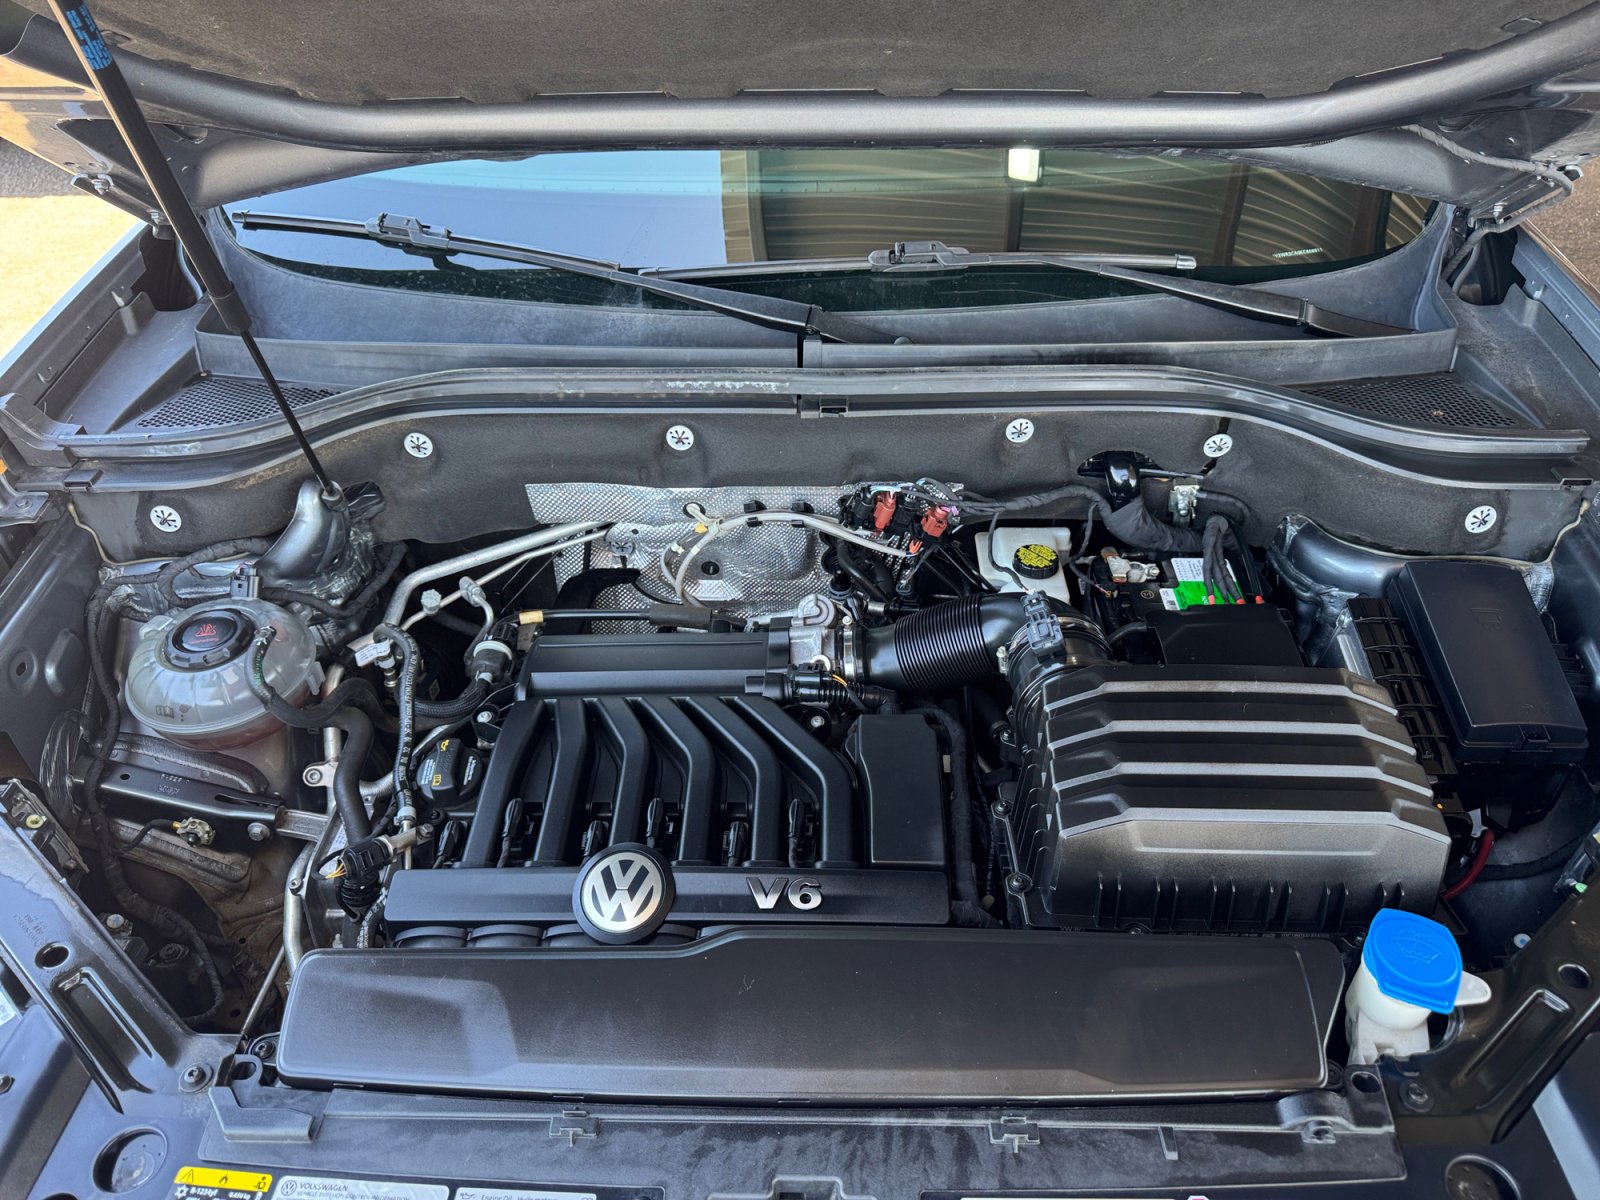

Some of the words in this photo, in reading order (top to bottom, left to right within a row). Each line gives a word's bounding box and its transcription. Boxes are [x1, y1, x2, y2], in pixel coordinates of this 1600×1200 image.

[582, 852, 664, 933] VW
[746, 876, 823, 911] V6
[300, 1182, 349, 1192] VOLKSWAGEN
